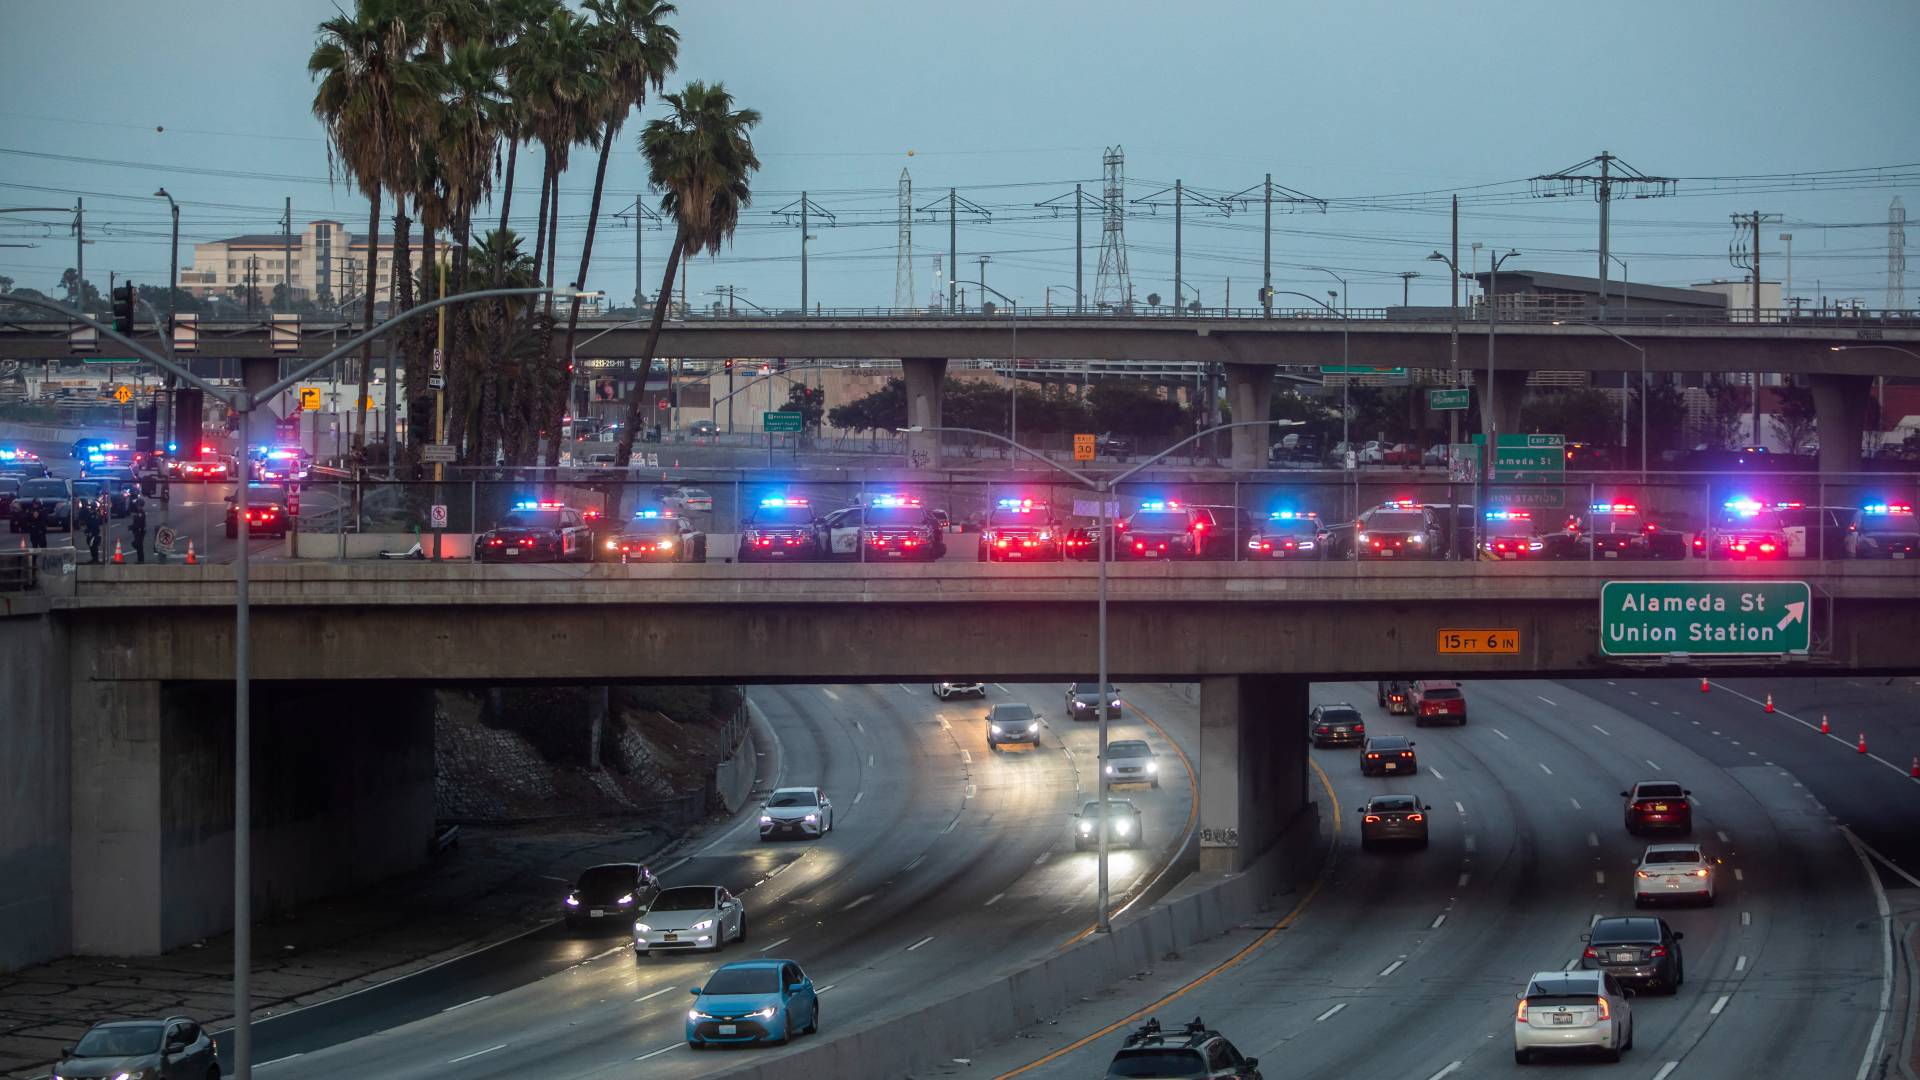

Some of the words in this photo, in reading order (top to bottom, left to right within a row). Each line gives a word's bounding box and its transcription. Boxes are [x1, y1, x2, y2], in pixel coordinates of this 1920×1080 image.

[1548, 437, 1561, 445] 2A
[1491, 457, 1534, 465] ameda
[1515, 495, 1558, 503] STATION
[1622, 593, 1725, 612] Alameda
[1740, 593, 1765, 612] St
[1610, 623, 1676, 641] Union
[1689, 623, 1774, 641] Station
[1444, 635, 1461, 649] 15
[1463, 639, 1478, 649] FT
[1487, 634, 1498, 649] 6
[1502, 639, 1514, 649] IN
